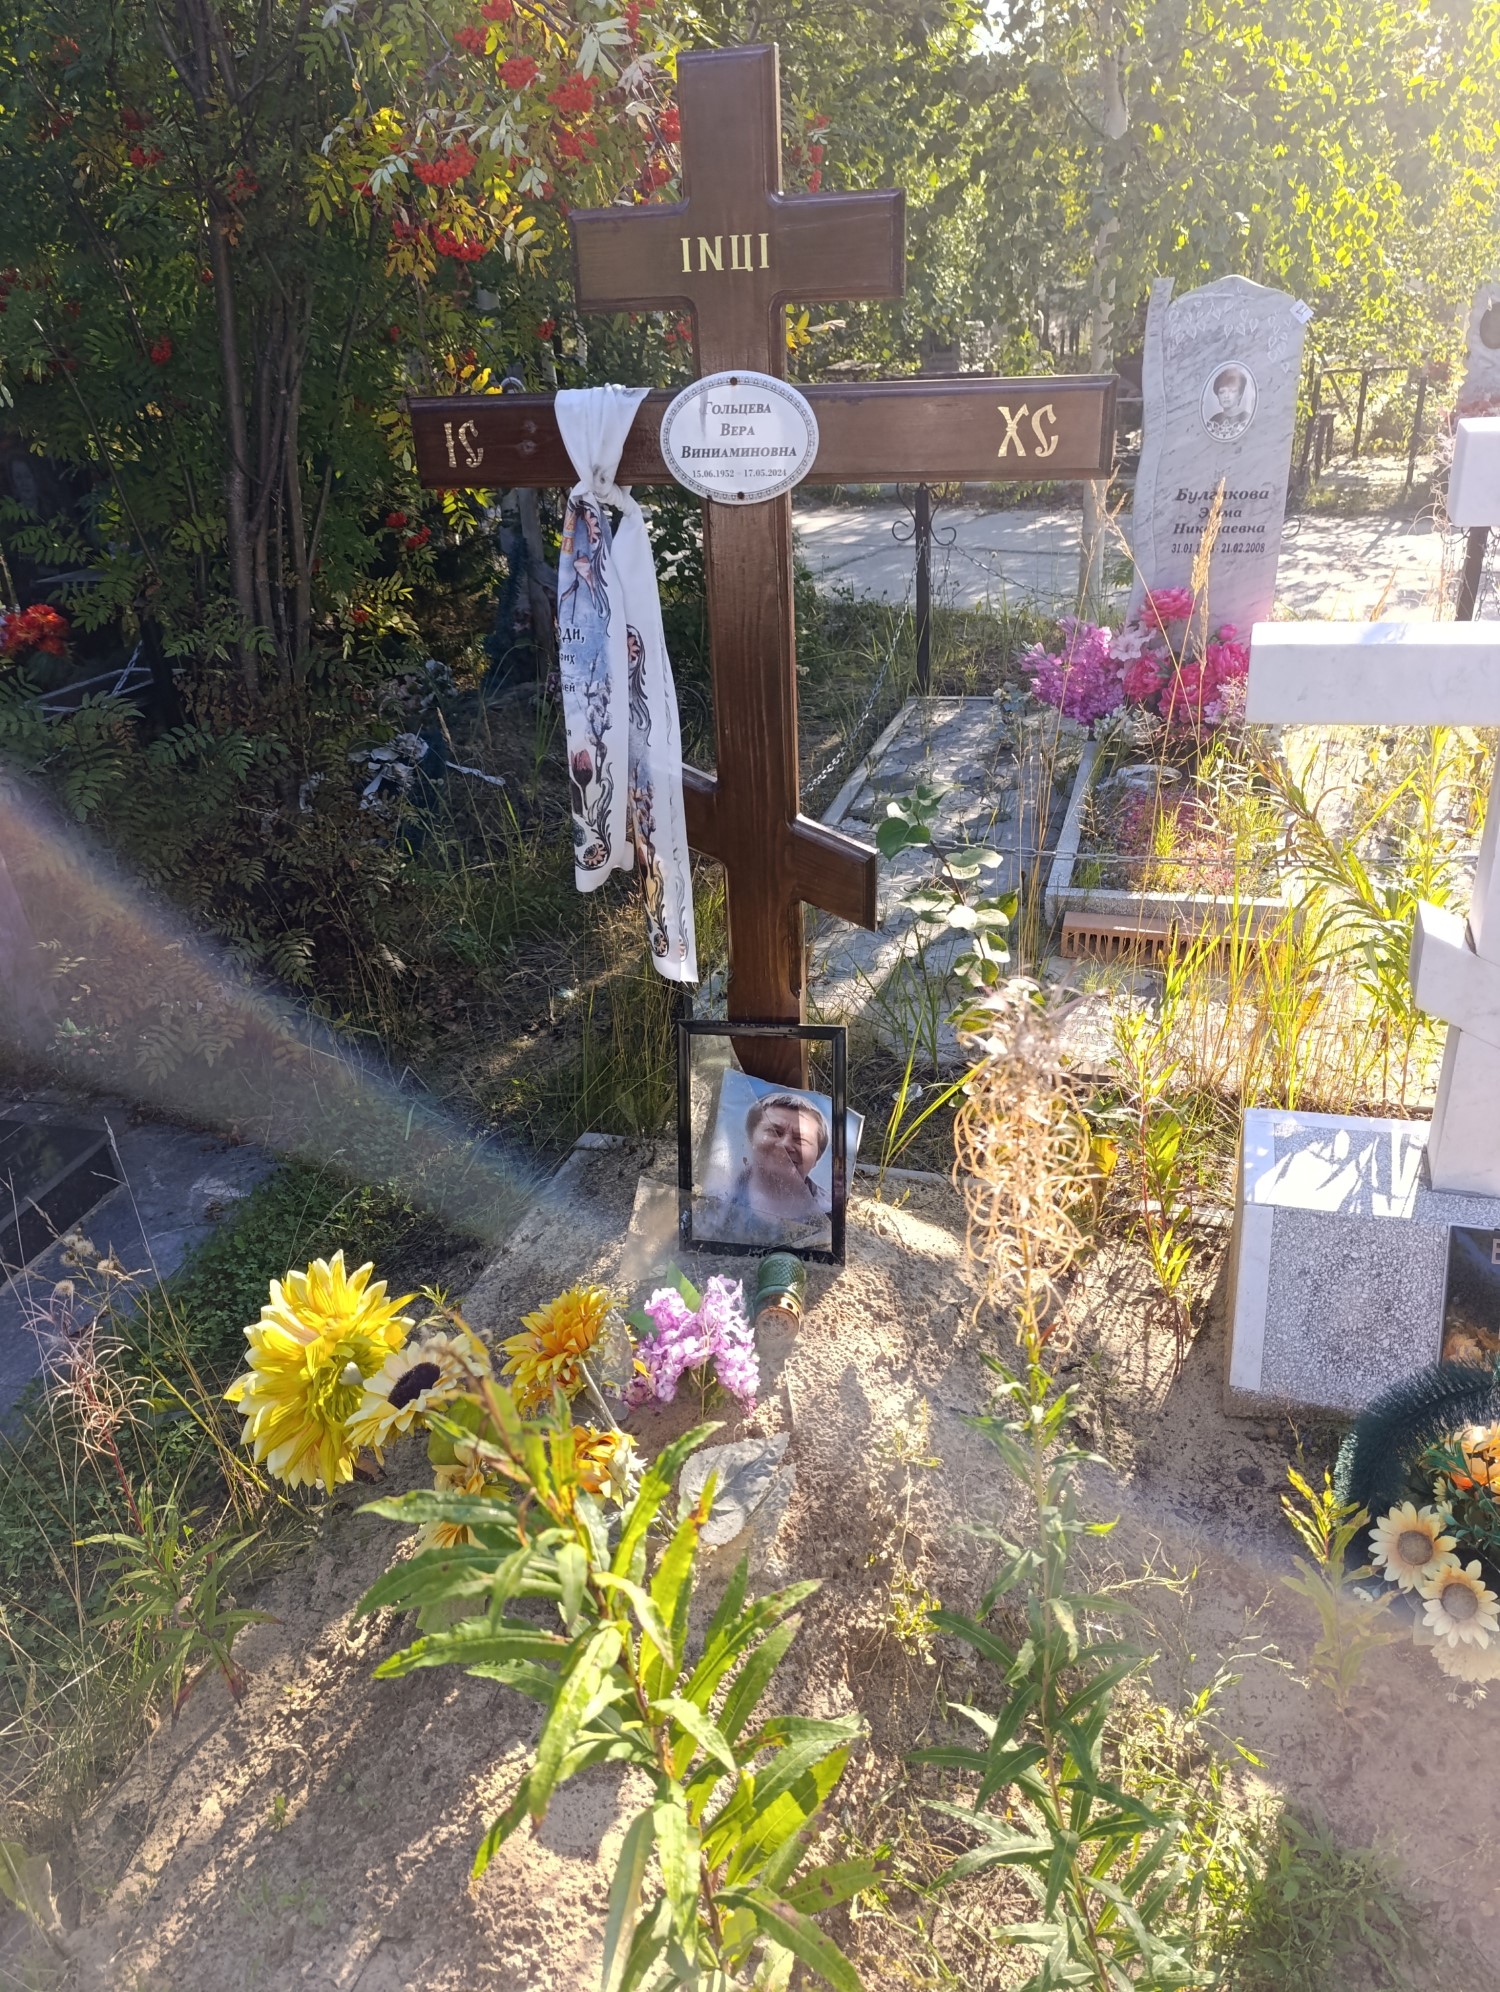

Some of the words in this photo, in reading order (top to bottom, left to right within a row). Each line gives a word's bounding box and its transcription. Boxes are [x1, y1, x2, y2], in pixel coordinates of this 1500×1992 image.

[704, 401, 772, 416] ГОЛЬЦЕВА
[719, 422, 756, 437] ВЕРА
[680, 445, 797, 459] ВИНИАМИНОВНА
[692, 469, 735, 479] 15.06.1952
[743, 468, 787, 478] 17.05.2024
[1199, 507, 1242, 519] Эма
[1173, 523, 1266, 535] Никаевна
[1220, 542, 1266, 554] 21.02.2008
